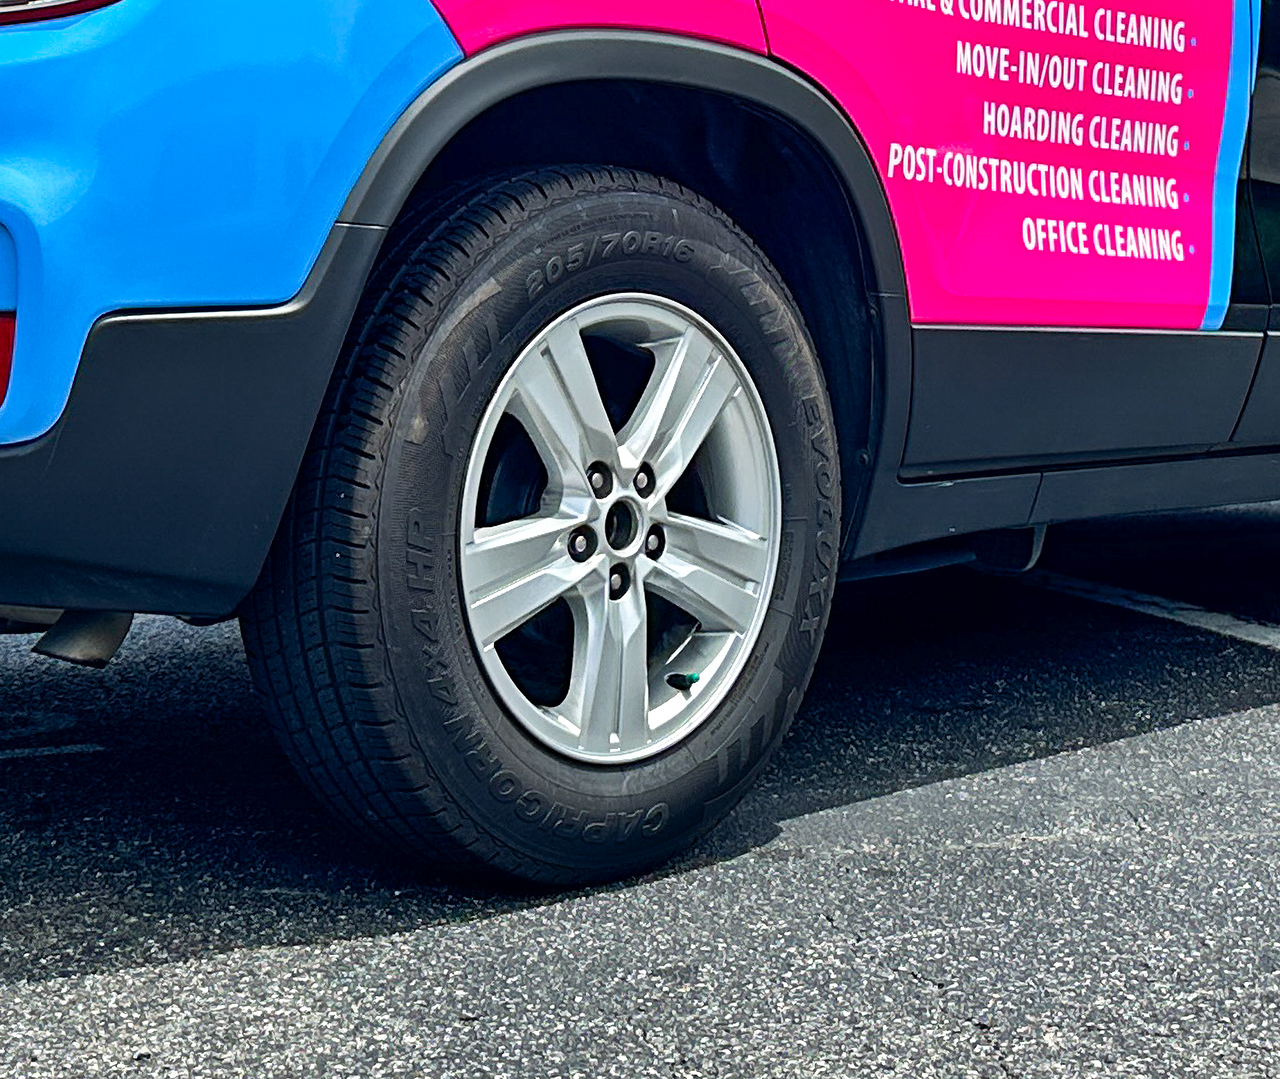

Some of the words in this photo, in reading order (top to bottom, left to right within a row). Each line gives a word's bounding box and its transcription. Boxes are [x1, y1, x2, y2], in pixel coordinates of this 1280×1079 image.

[1093, 7, 1185, 53] CLEANING
[956, 40, 1087, 91] MOVE-IN/OUT
[1092, 61, 1183, 105] CLEANING
[983, 101, 1084, 146] HOARDING
[1088, 116, 1179, 157] CLEANING
[887, 143, 1084, 201] POST-CONSTRUCTION
[1088, 169, 1179, 209] CLEANING
[526, 230, 695, 300] 205/70R16
[1022, 217, 1089, 255] OFFICE
[1093, 223, 1184, 261] CLEANING
